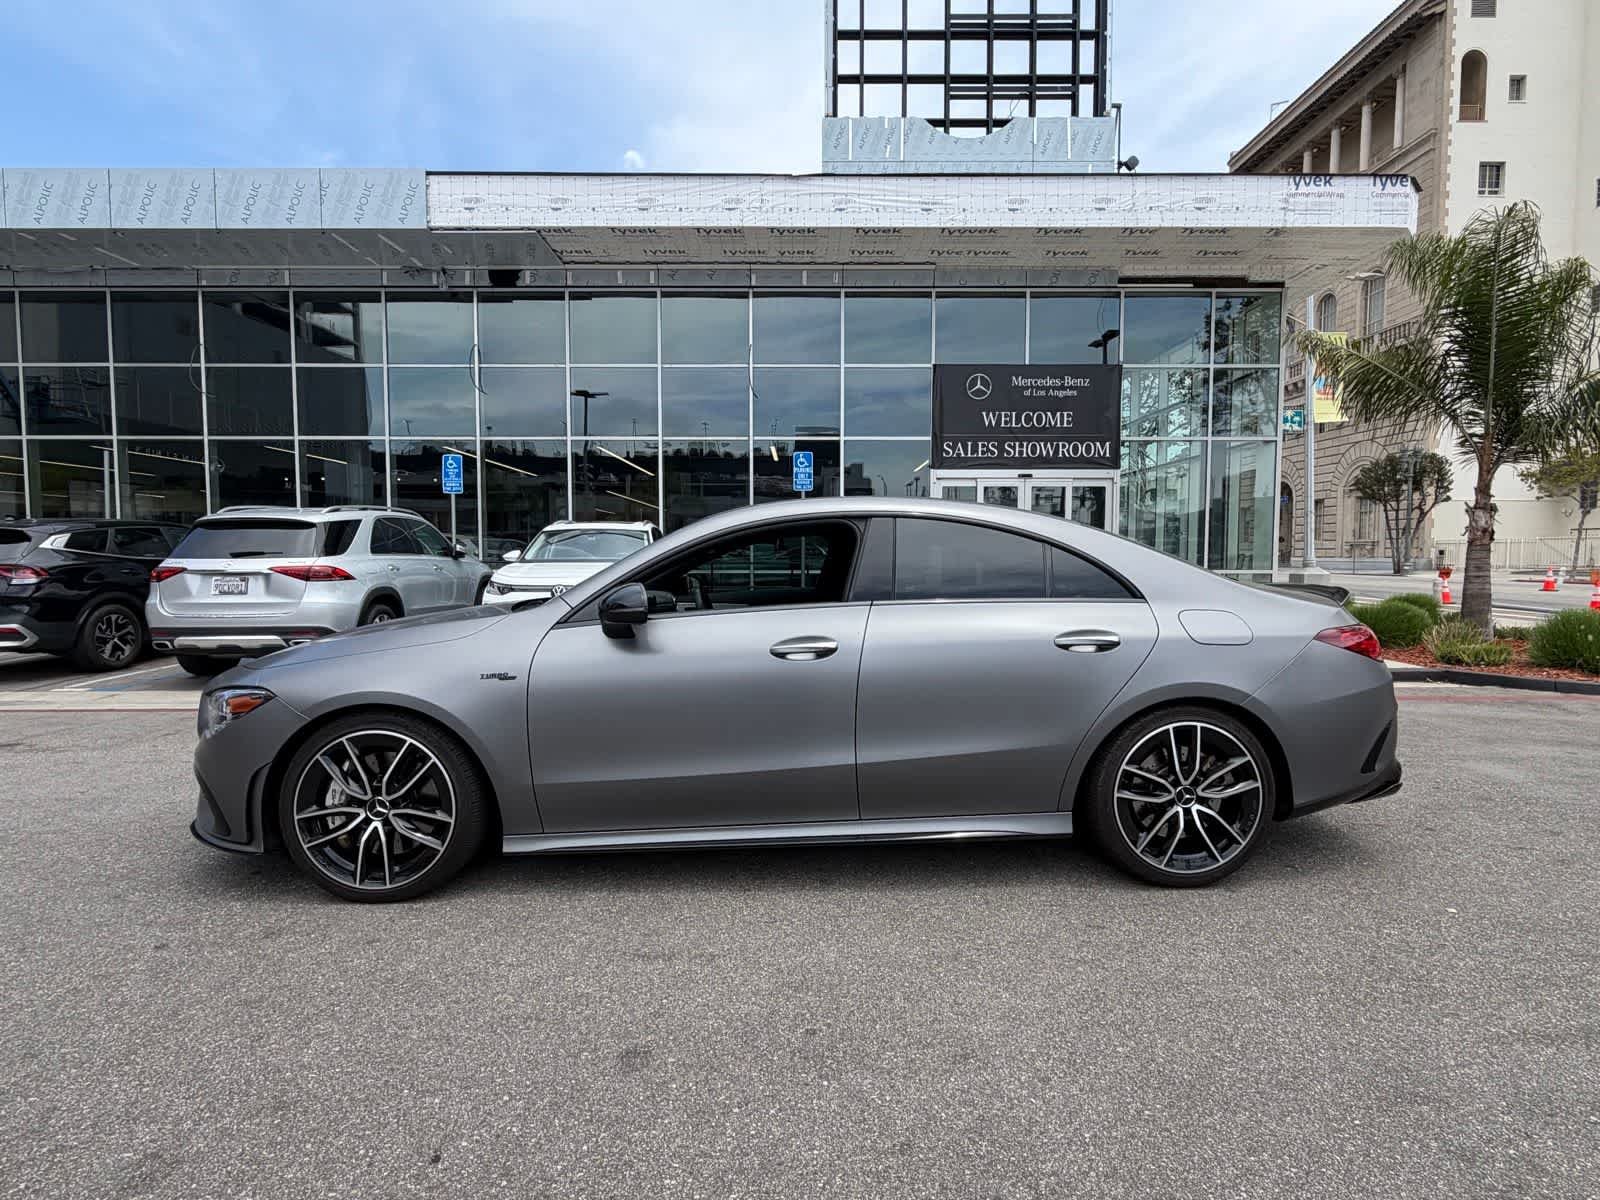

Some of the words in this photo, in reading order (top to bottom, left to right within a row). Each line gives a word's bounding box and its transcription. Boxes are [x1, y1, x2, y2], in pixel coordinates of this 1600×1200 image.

[33, 178, 54, 224] ALPOLIC
[77, 177, 98, 224] ALPOLIC
[136, 178, 157, 224] ALPOLIC
[180, 178, 201, 224] ALPOLIC
[241, 178, 262, 224] ALPOLIC
[285, 178, 306, 224] ALPOLIC
[353, 178, 375, 224] ALPOLIC
[398, 178, 420, 224] ALPOLIC
[606, 227, 658, 235] Tyvek
[693, 227, 745, 235] Tyvek
[767, 227, 817, 235] Tyvek
[855, 227, 903, 235] Tyvek
[1036, 227, 1085, 236] Tyvek
[1044, 249, 1089, 257] Tyvek
[1011, 375, 1090, 387] Mercedes-Benz
[1048, 389, 1078, 398] Angeles
[982, 411, 1073, 428] WELCOME
[942, 441, 998, 458] SALES
[1003, 441, 1112, 458] SHOWROOM
[480, 672, 509, 680] TURBO
